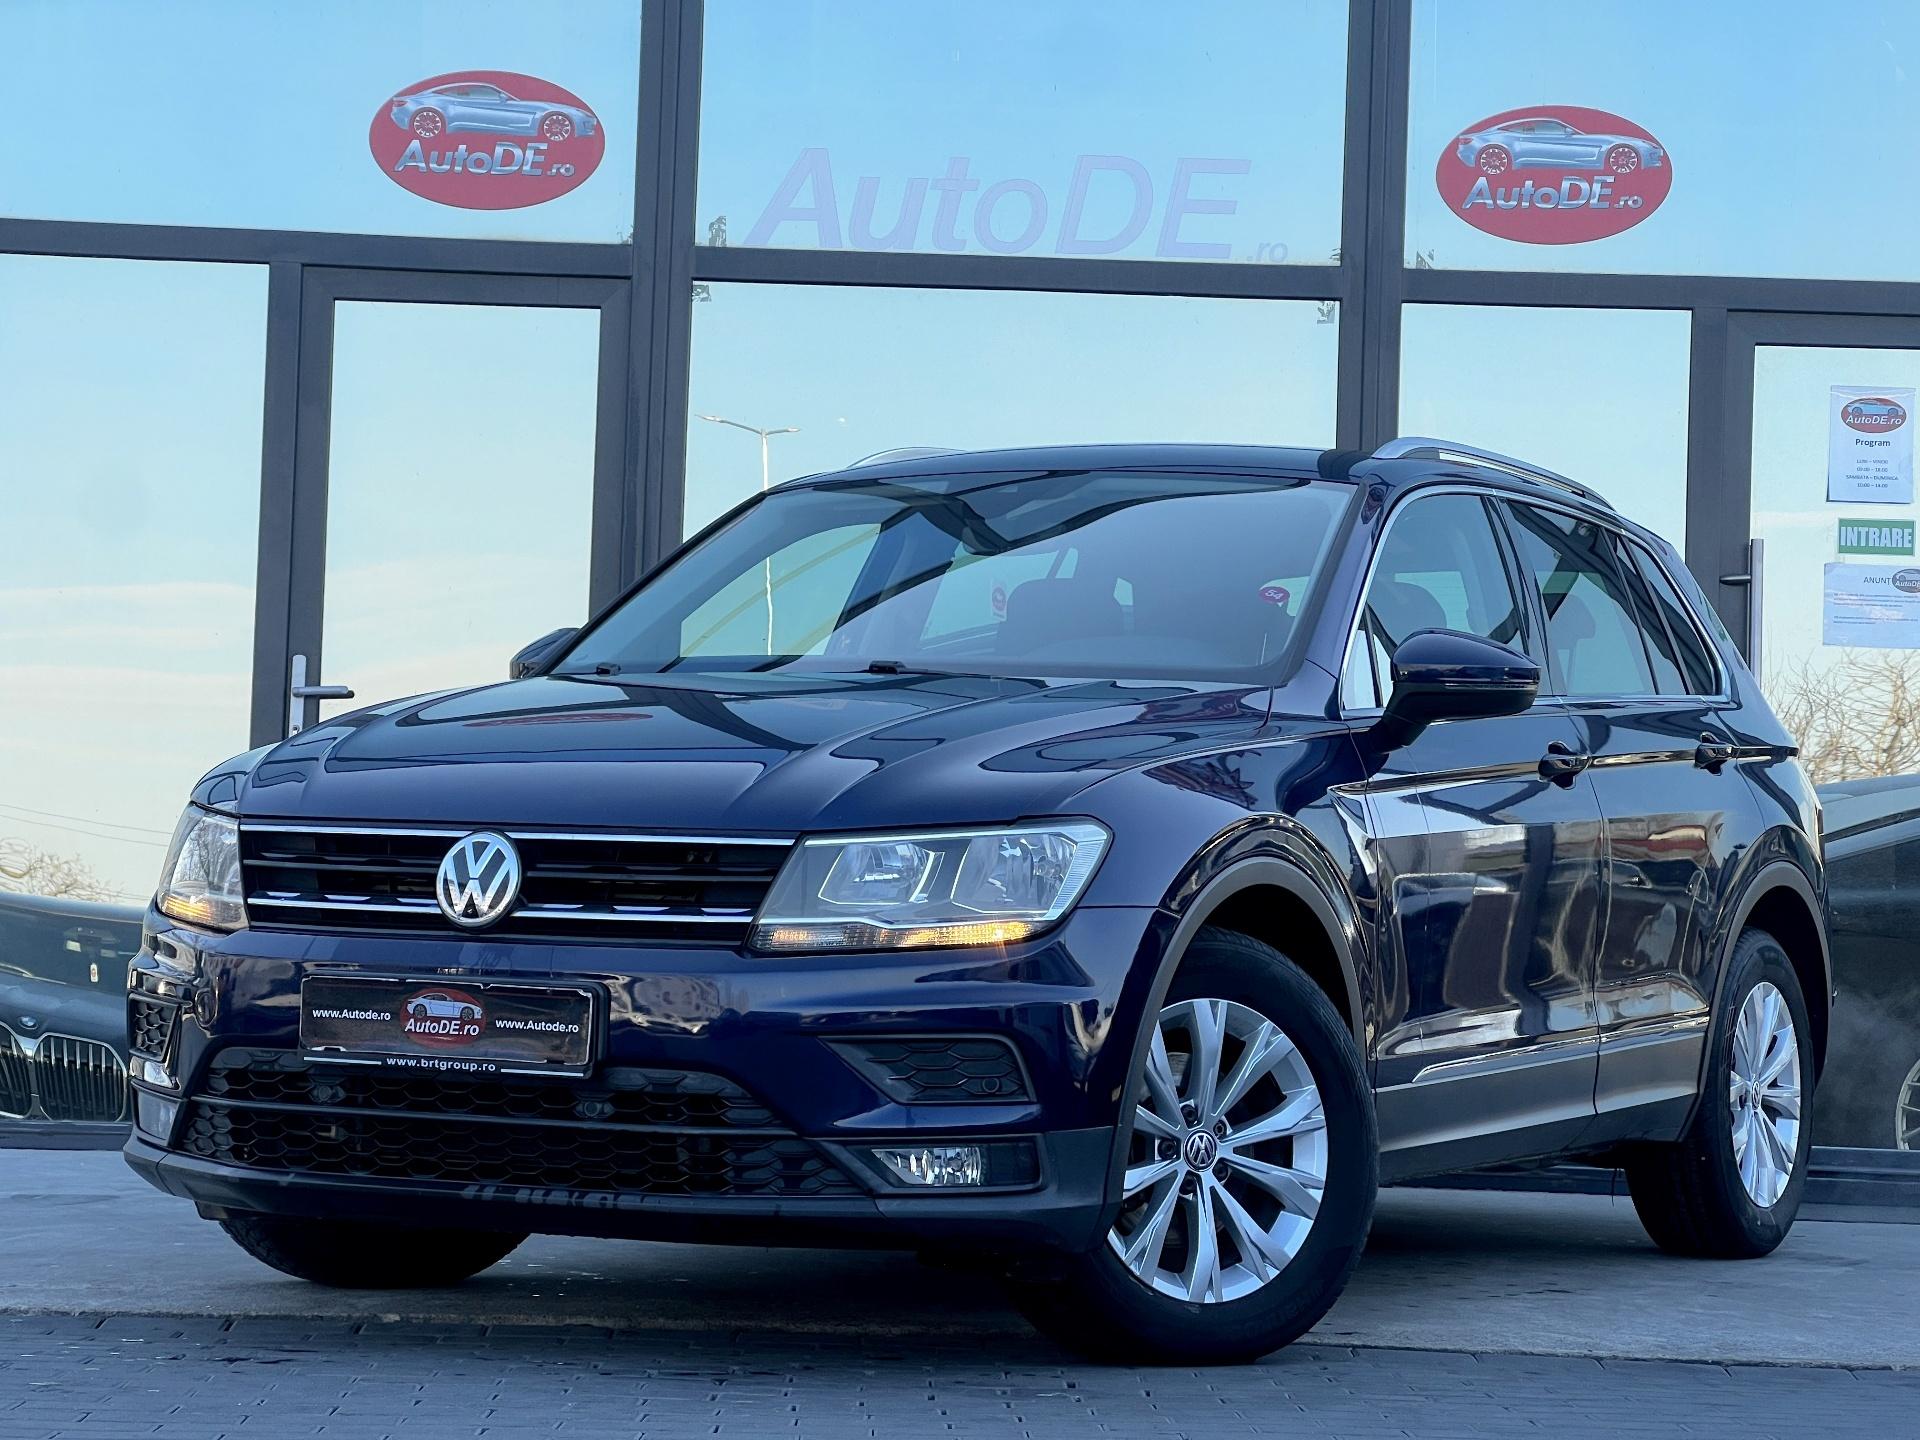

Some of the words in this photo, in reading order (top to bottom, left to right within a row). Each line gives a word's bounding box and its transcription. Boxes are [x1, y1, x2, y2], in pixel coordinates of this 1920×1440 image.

[1845, 415, 1902, 425] AutoDE.ro
[1855, 438, 1891, 448] Program
[1840, 526, 1912, 548] INTRARE
[312, 1008, 391, 1021] www.Autode.ro
[404, 1018, 480, 1036] AutoDE.ro
[495, 1018, 579, 1033] www.Autode.ro
[386, 1057, 496, 1072] www.brtgroup.ro
